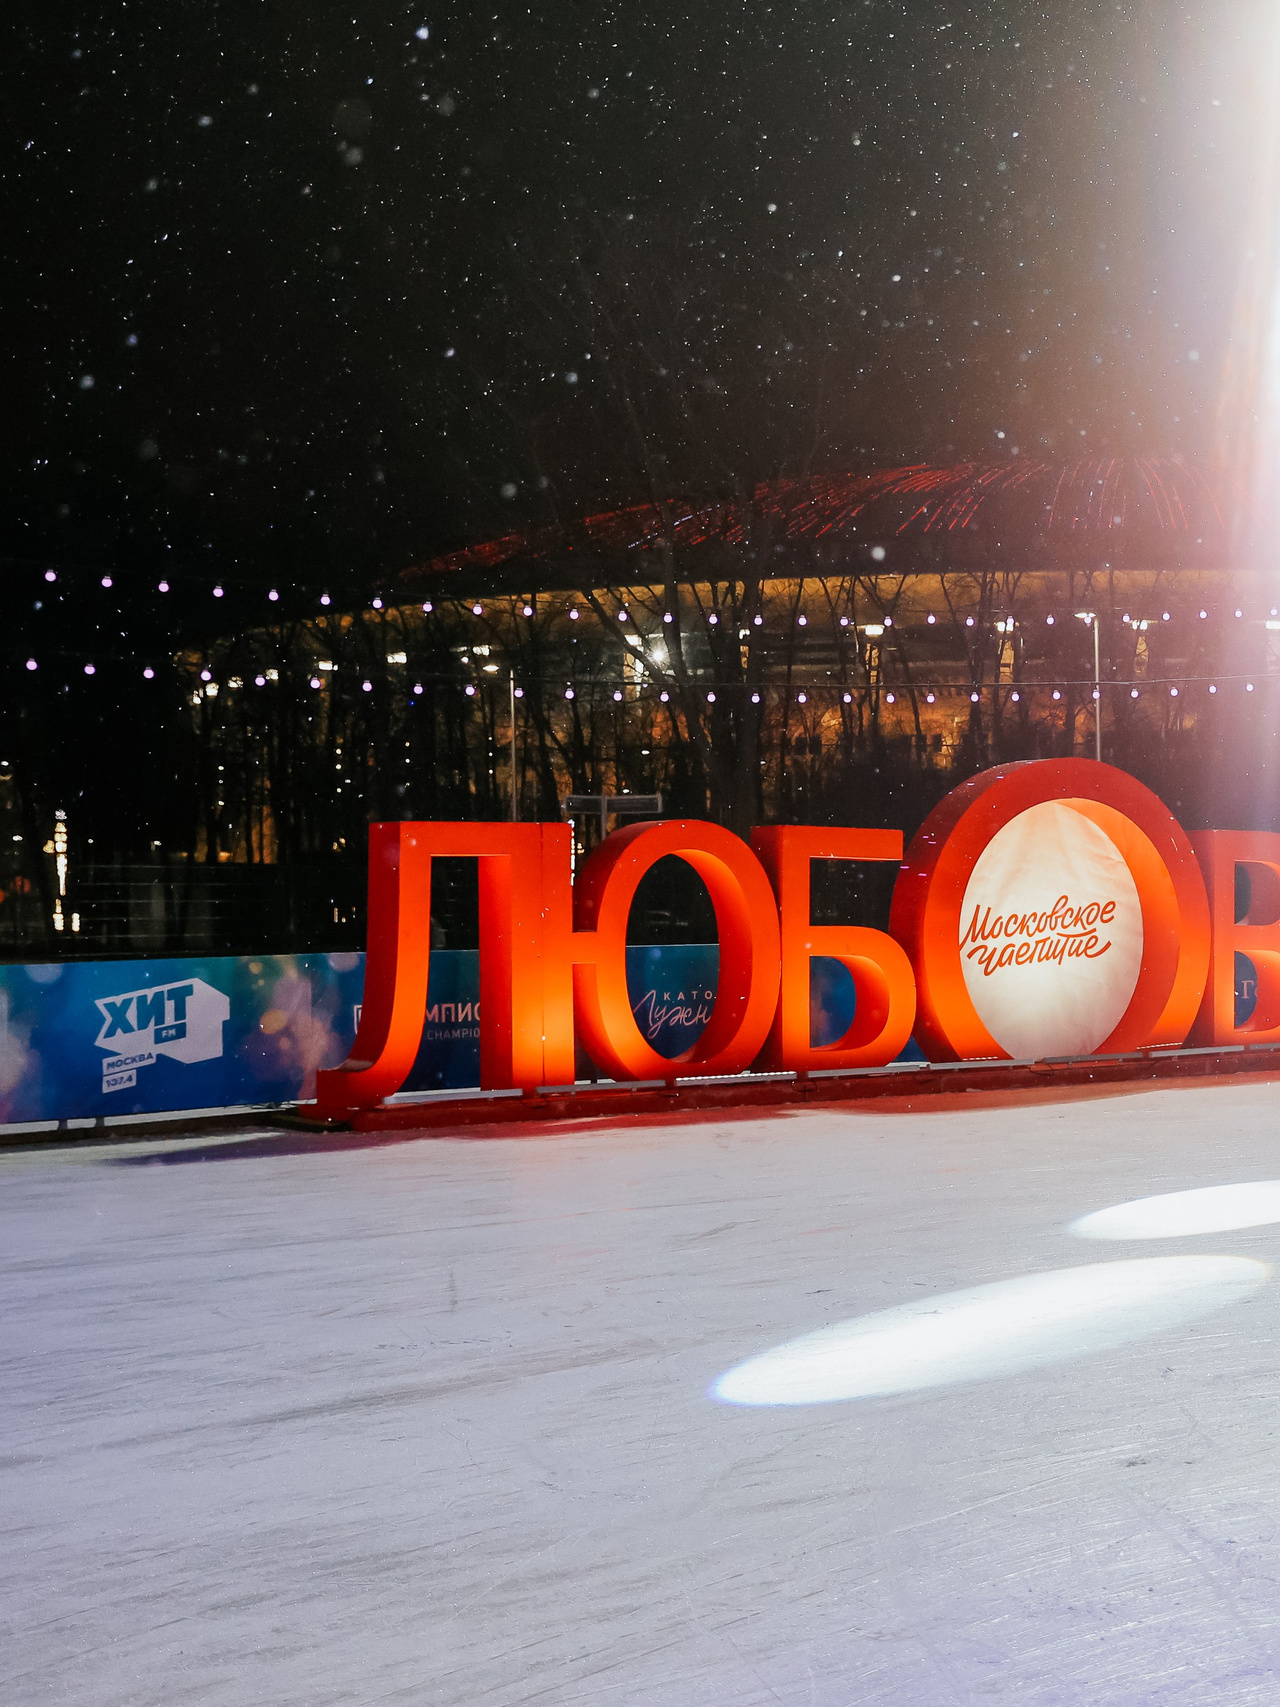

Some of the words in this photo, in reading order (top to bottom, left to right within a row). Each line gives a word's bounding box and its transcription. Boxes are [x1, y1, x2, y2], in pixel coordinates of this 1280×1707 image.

[959, 894, 1117, 952] Московское
[966, 927, 1112, 977] чаепитие
[102, 983, 194, 1039] ХИТ
[162, 1028, 176, 1038] FM
[106, 1051, 154, 1071] МОСКВА
